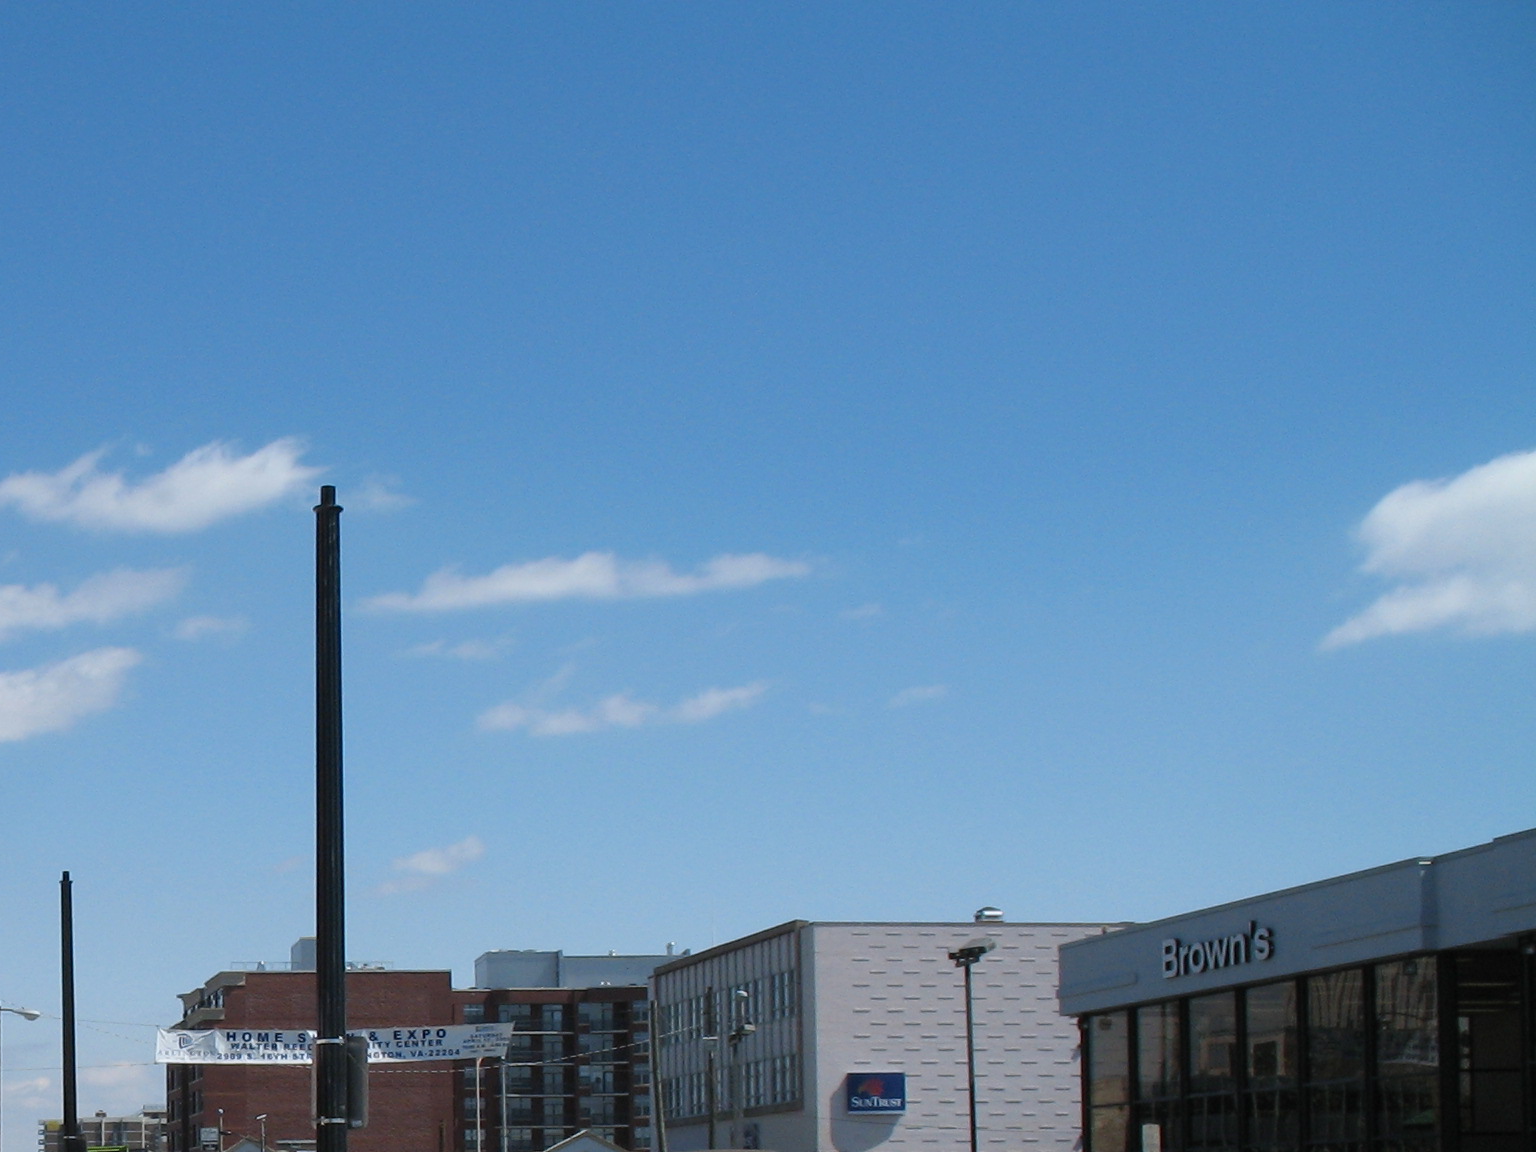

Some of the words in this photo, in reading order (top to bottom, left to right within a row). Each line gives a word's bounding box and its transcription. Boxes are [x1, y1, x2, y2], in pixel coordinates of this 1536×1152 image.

[1163, 920, 1271, 979] Brown's
[226, 1031, 284, 1043] HOME
[369, 1031, 379, 1041] &
[393, 1028, 447, 1041] EXPO
[231, 1042, 278, 1051] WALTER
[395, 1039, 443, 1049] CENTER
[410, 1048, 461, 1058] VA-22204
